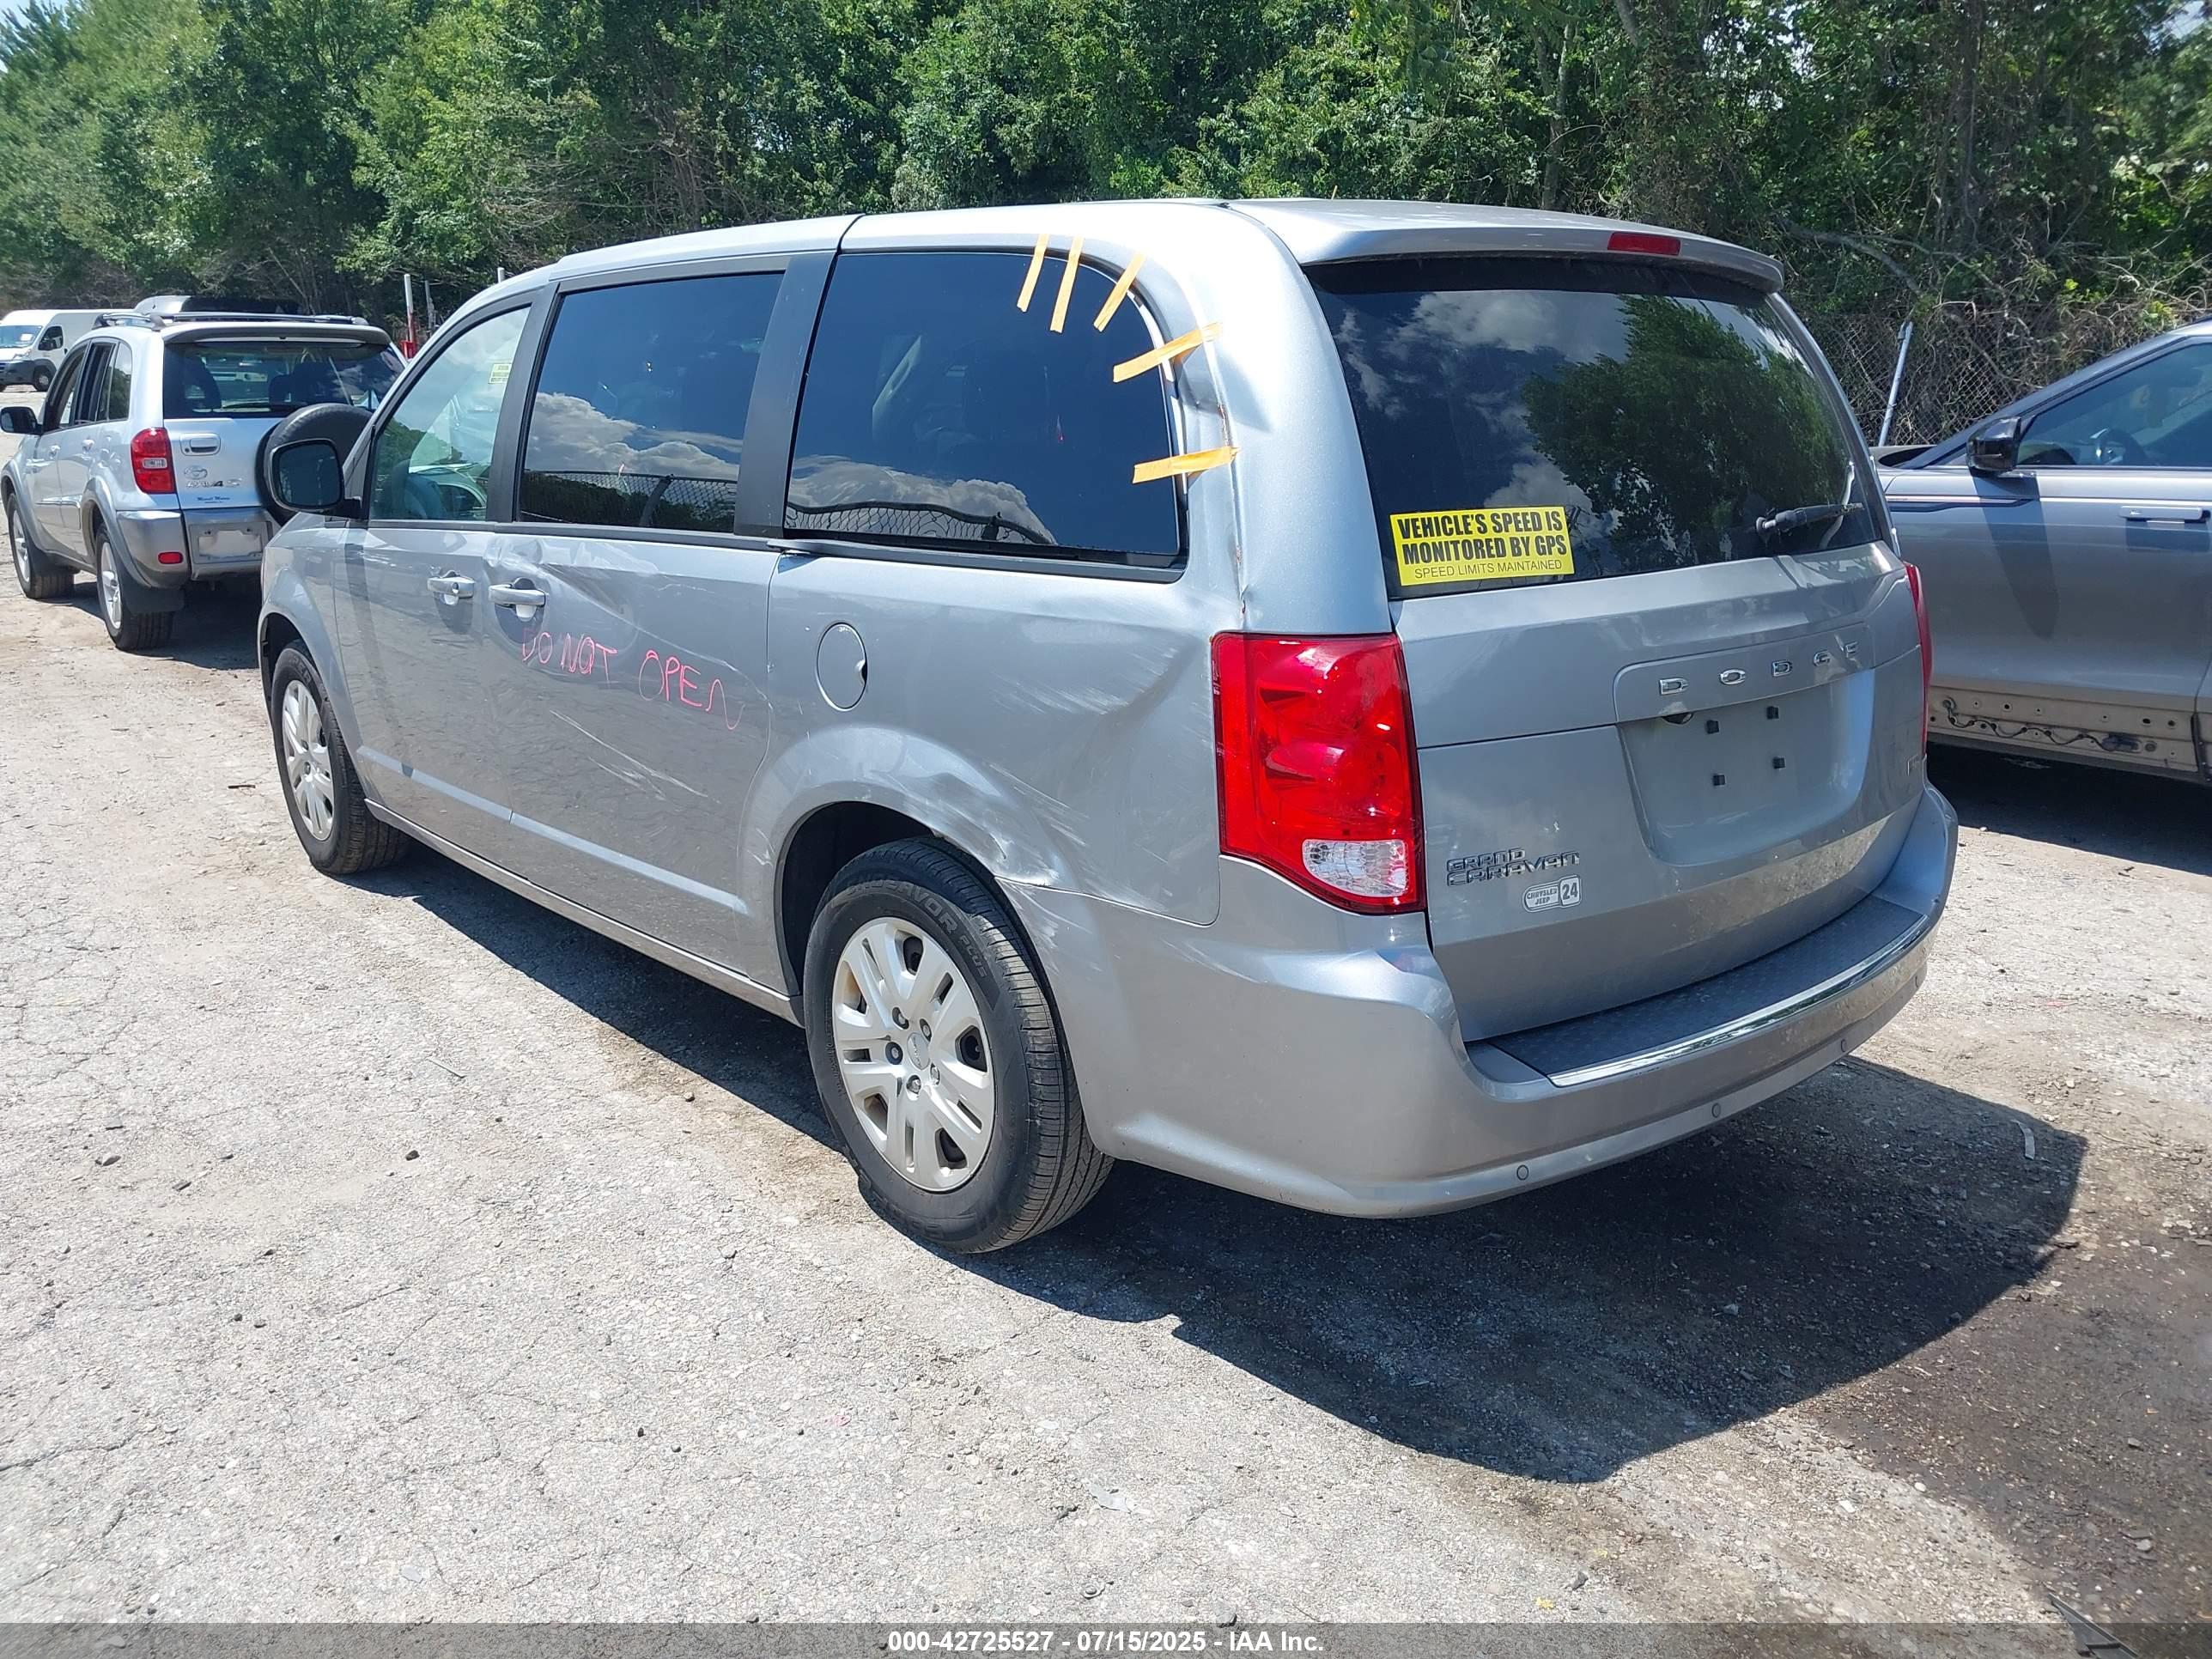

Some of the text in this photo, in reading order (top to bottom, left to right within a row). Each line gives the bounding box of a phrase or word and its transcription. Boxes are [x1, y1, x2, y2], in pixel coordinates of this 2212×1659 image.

[1396, 510, 1564, 539] VEHICLE'S SPEED IS
[1402, 535, 1567, 565] MONITORED BY GPS
[1414, 559, 1562, 580] SPEED LIMITS MAINTAINED
[522, 629, 553, 663] DO
[560, 632, 618, 690] NOT
[1659, 640, 1860, 696] DODGE
[1447, 848, 1526, 872] GRAND
[1447, 851, 1580, 886] CARAVAN
[1562, 882, 1579, 901] 24
